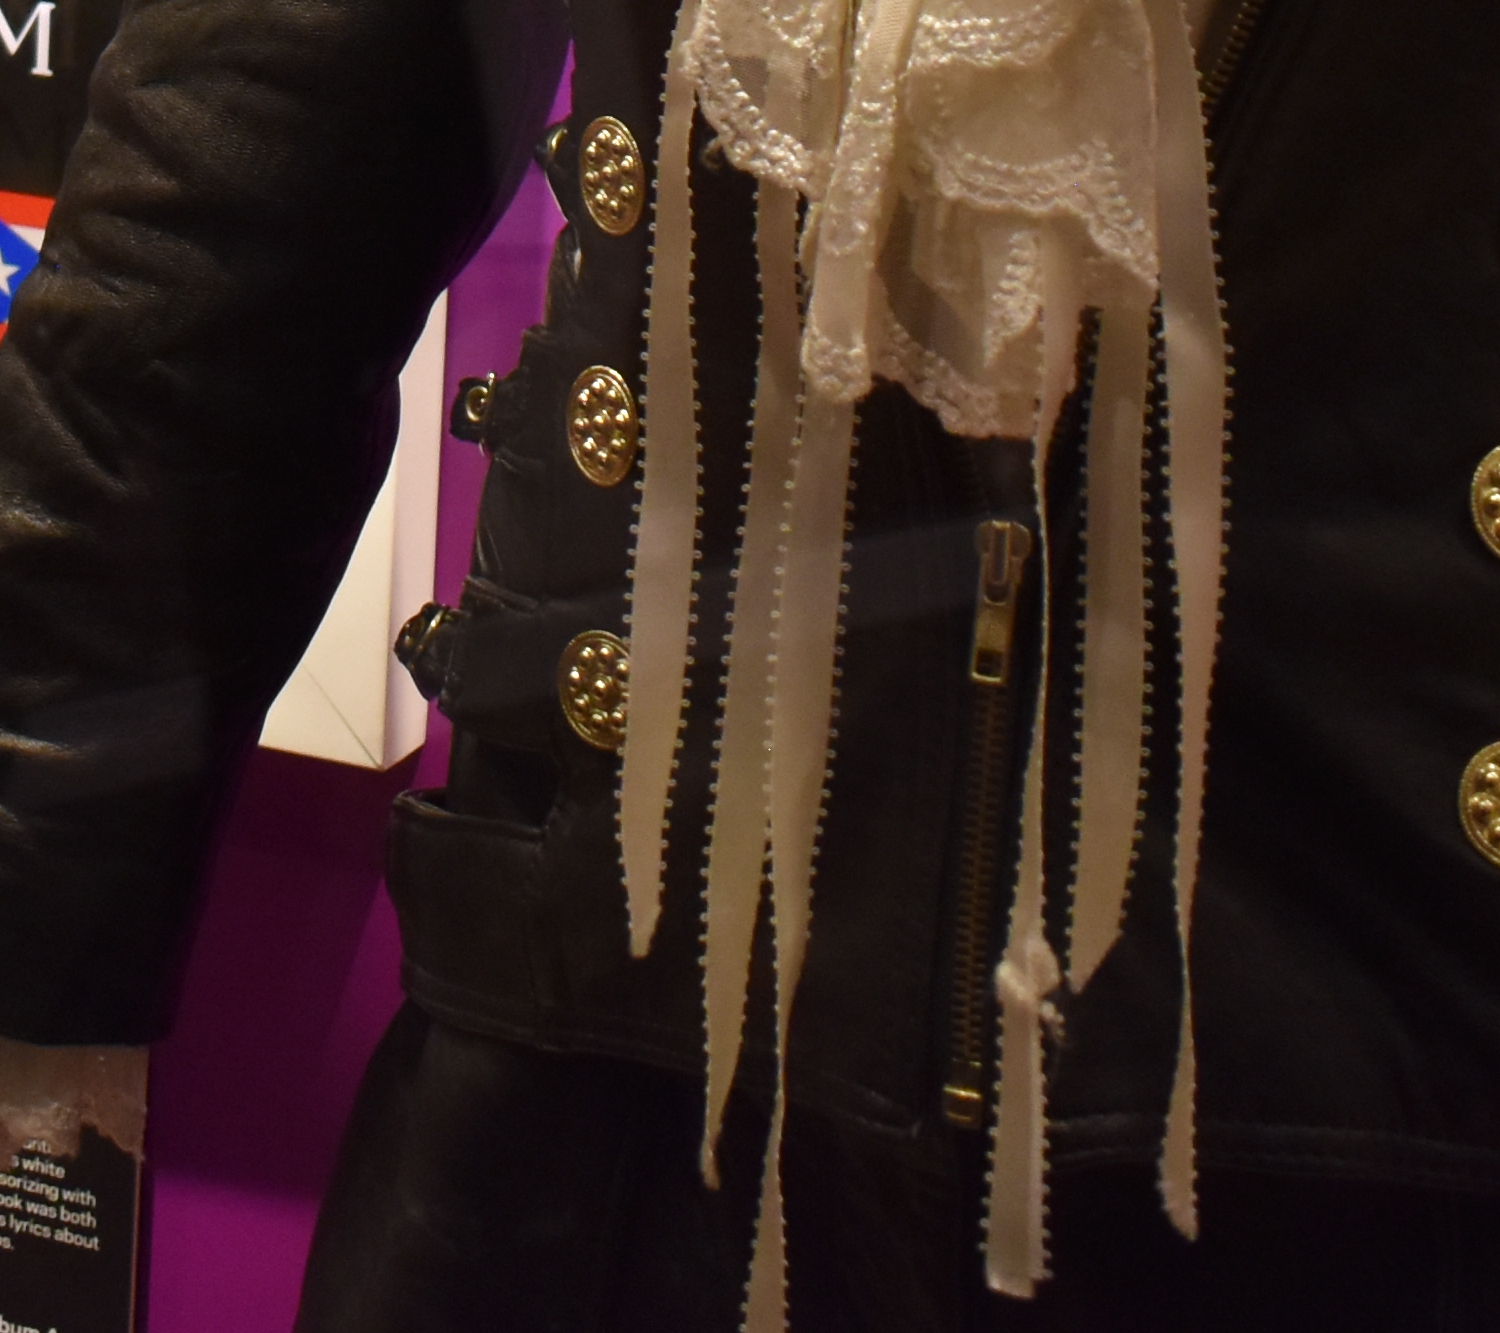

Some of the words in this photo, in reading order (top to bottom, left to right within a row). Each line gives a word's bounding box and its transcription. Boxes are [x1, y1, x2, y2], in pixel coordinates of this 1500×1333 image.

[21, 1157, 66, 1179] white
[61, 1187, 97, 1208] with
[25, 1200, 58, 1219] was
[59, 1205, 97, 1230] both
[8, 1213, 52, 1238] lyrics
[54, 1227, 100, 1252] about
